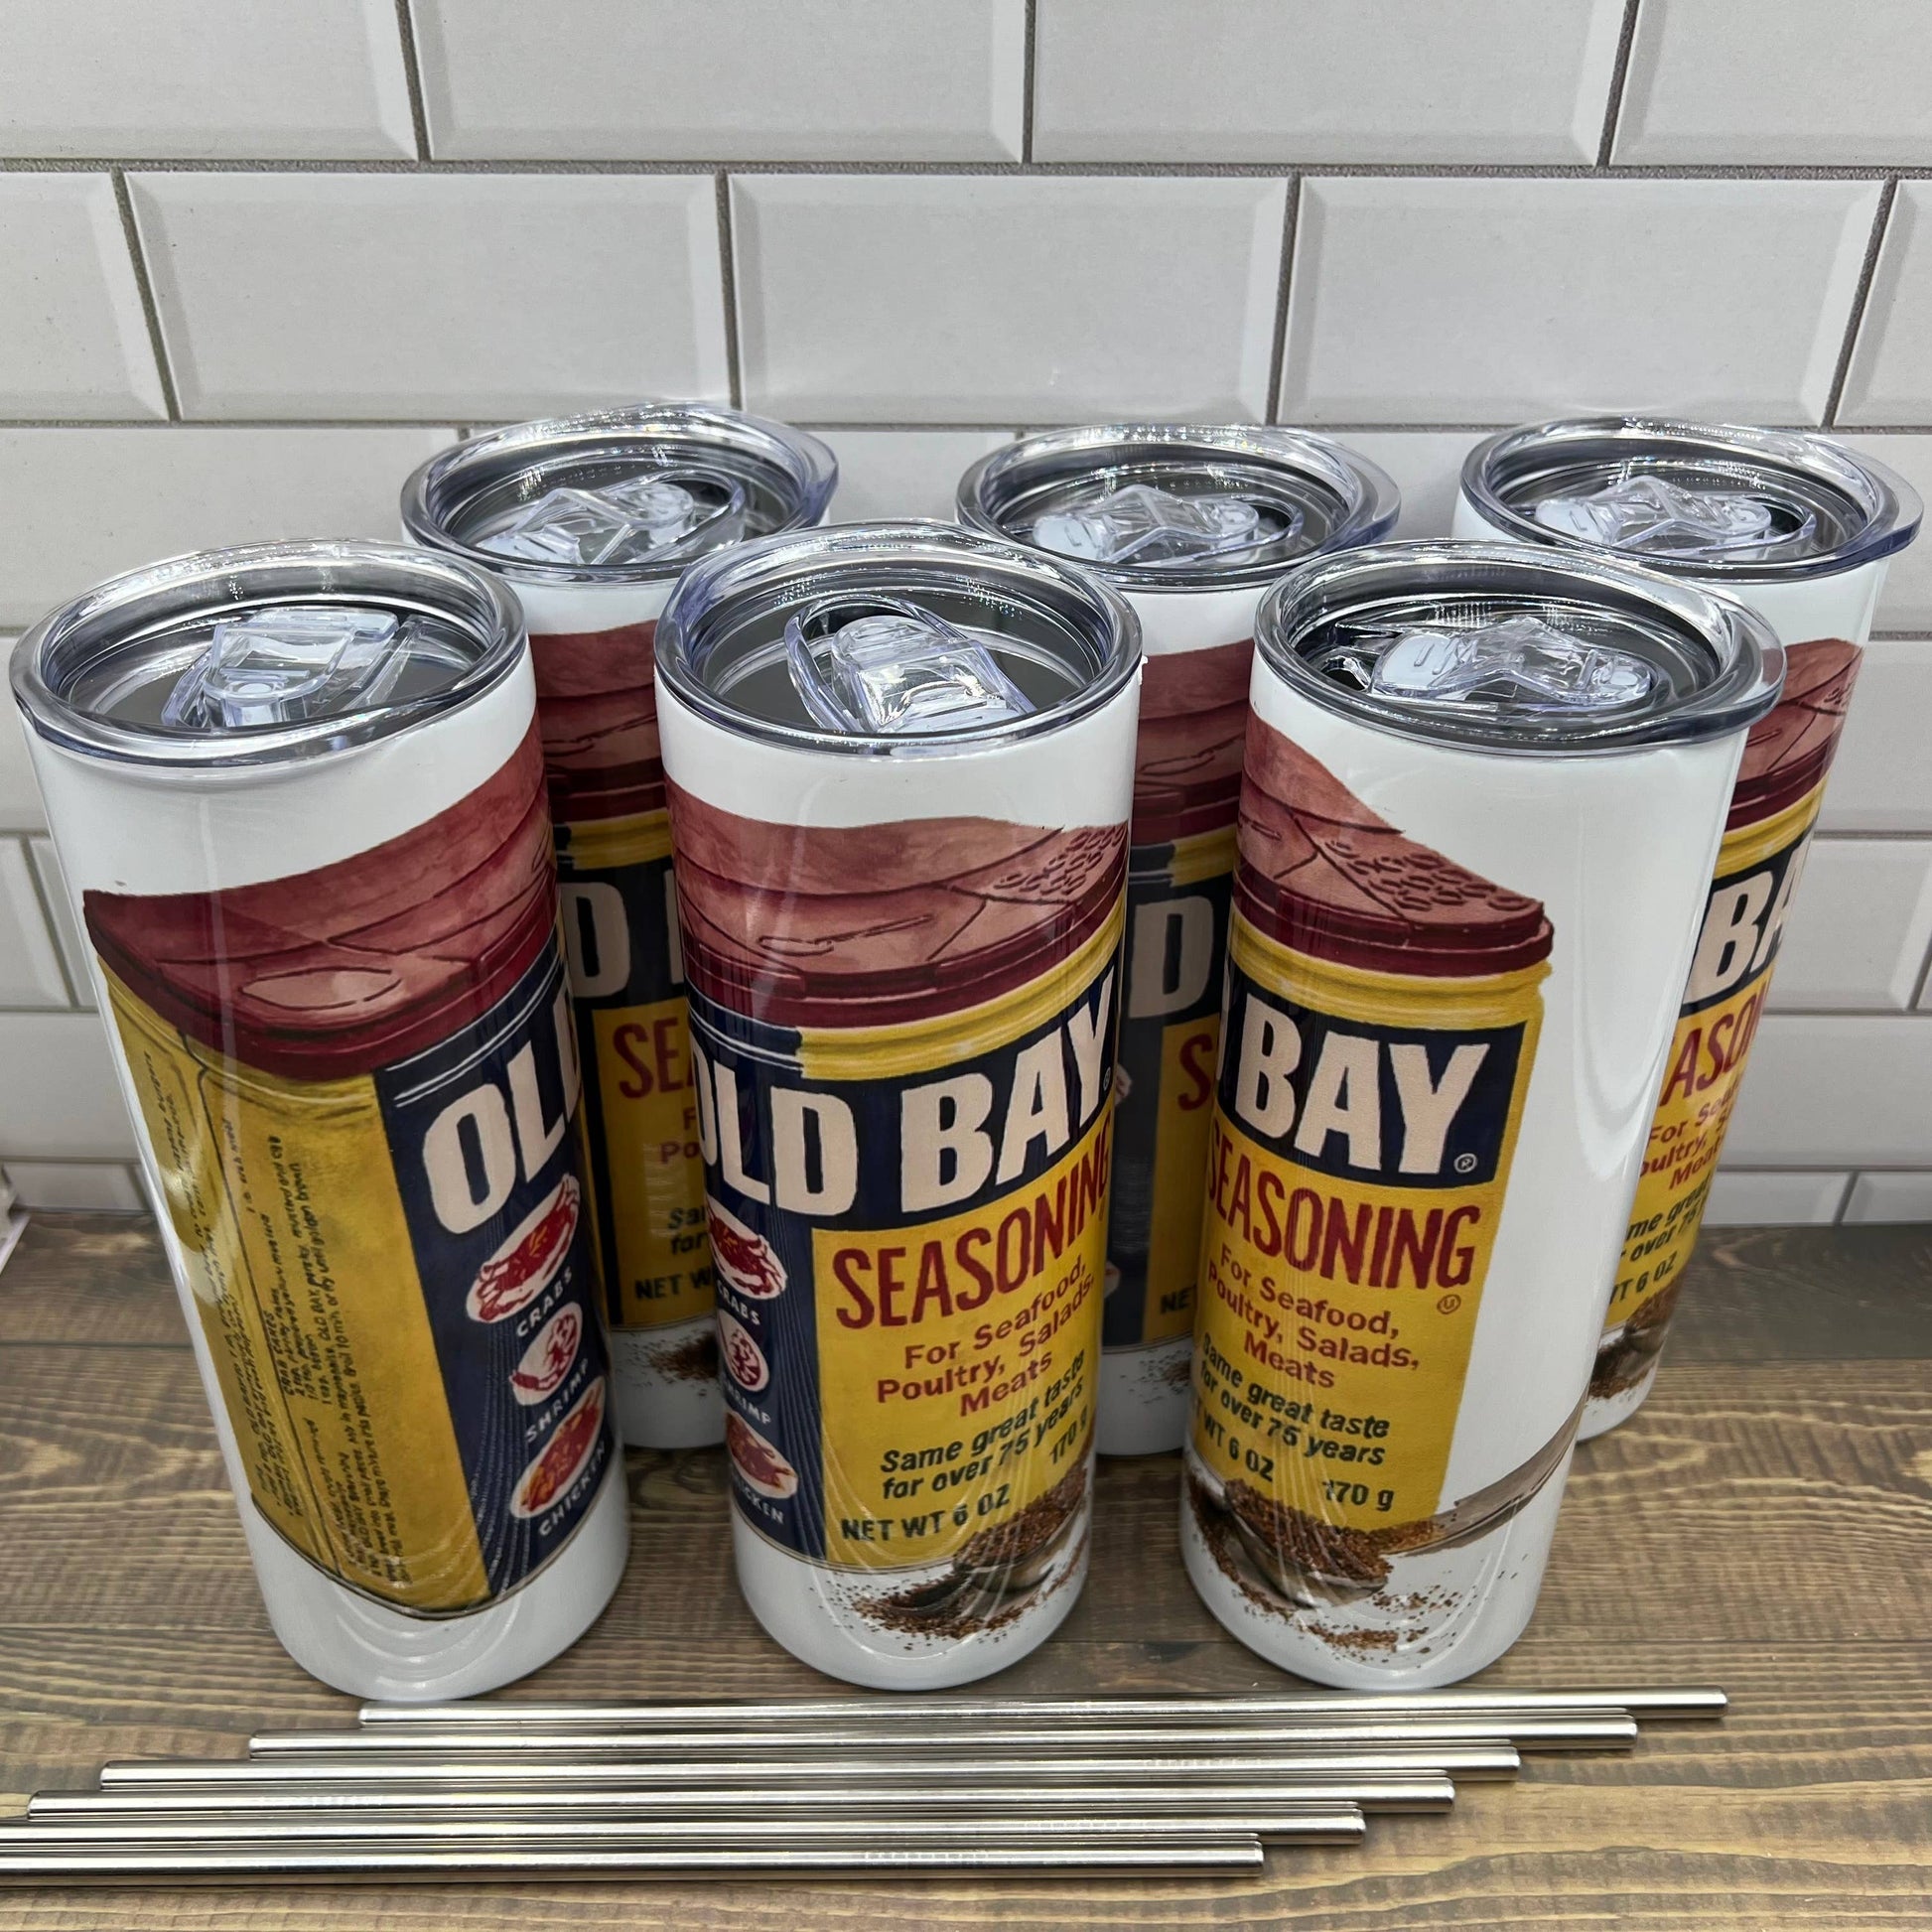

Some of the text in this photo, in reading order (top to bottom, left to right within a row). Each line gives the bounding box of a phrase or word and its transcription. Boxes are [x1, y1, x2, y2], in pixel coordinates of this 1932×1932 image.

[900, 966, 1114, 1213] BAY
[1236, 993, 1488, 1174] BAY
[833, 1117, 1111, 1329] SEASONING
[1208, 1118, 1481, 1290] SEASONING
[516, 1266, 572, 1337] CRABS
[904, 1254, 1085, 1369] For Seafood,
[1208, 1259, 1419, 1370] Poultry, Salads,
[1220, 1243, 1399, 1339] For Seafood,
[525, 1358, 589, 1443] SHRIMP
[878, 1355, 1005, 1403] Poultry,
[960, 1350, 1052, 1417] Meats
[1244, 1331, 1335, 1388] Meats
[881, 1349, 1085, 1473] Same great taste
[883, 1375, 1084, 1499] for over 75 years
[1221, 1391, 1264, 1430] over
[1268, 1417, 1301, 1447] 75
[1304, 1436, 1386, 1465] years
[1248, 1383, 1312, 1424] great
[1320, 1409, 1390, 1439] taste
[1229, 1438, 1239, 1460] 6
[1245, 1449, 1275, 1482] OZ
[1322, 1479, 1394, 1512] 170 g
[841, 1482, 1012, 1541] NET WT 6 OZ
